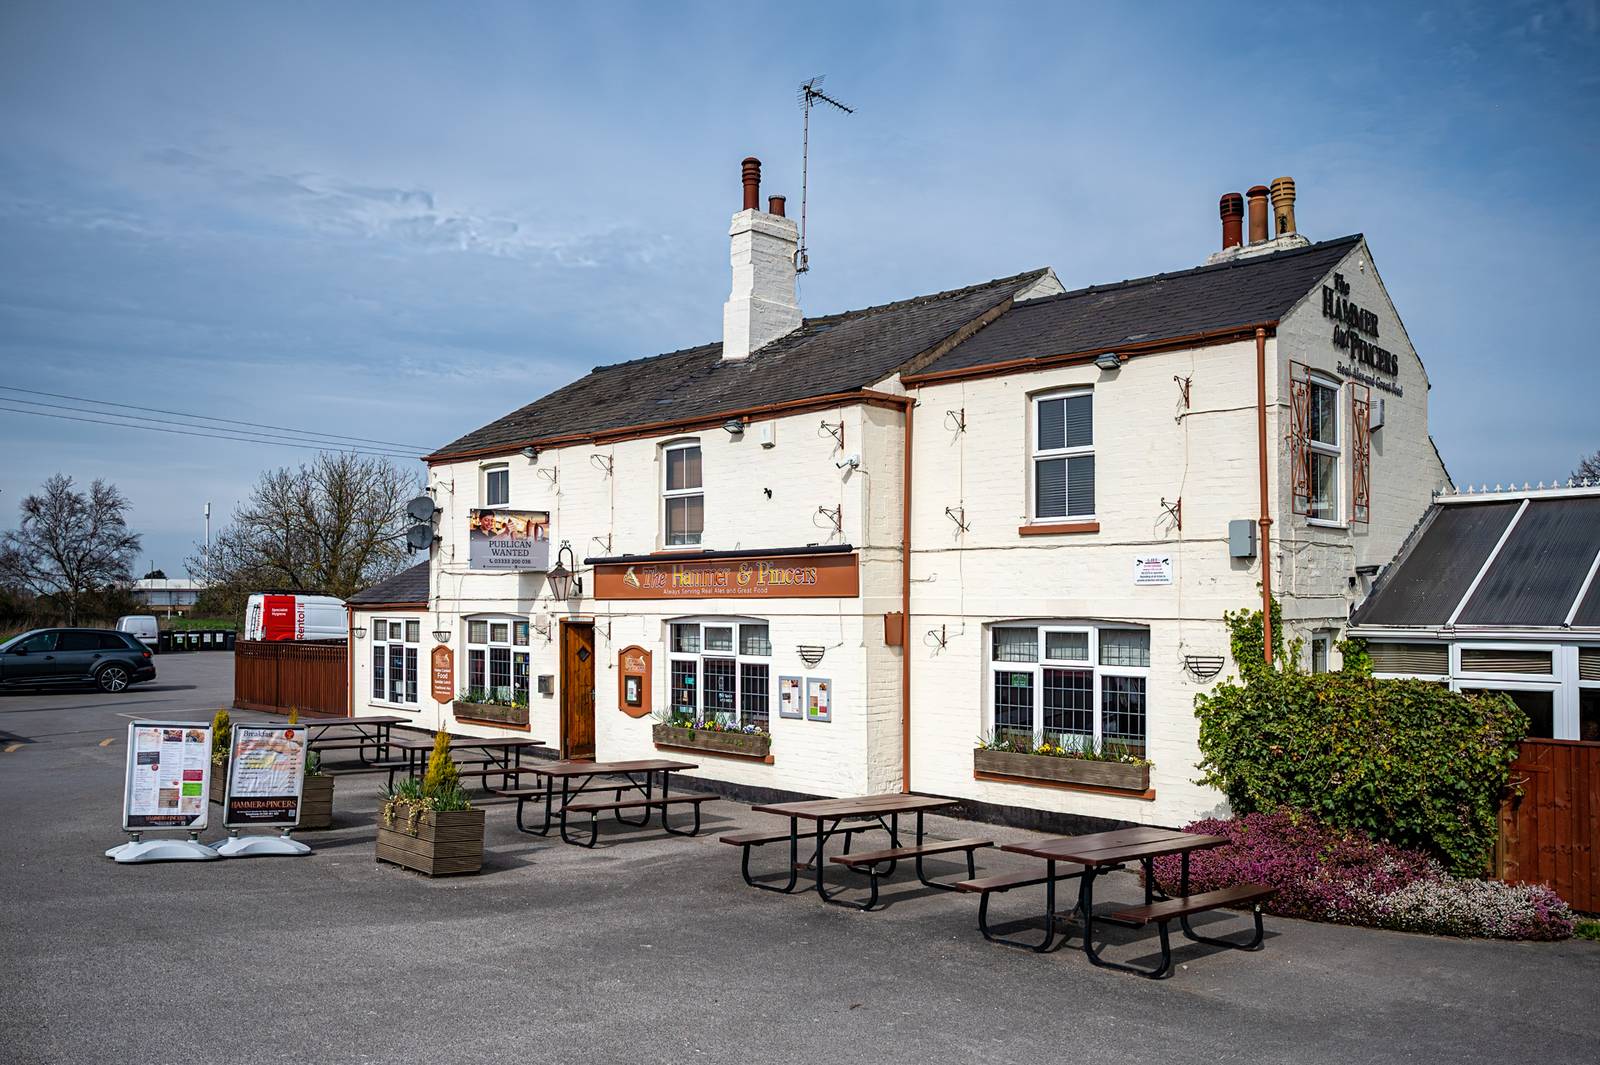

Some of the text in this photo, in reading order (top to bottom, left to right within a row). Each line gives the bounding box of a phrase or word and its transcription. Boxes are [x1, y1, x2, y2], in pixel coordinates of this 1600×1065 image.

[1334, 272, 1350, 296] The
[1322, 284, 1380, 338] HAMMER
[1350, 330, 1398, 376] PINCERS
[1336, 360, 1351, 376] Real
[489, 540, 532, 548] PUBLICAN
[642, 560, 817, 588] The Hammer & Pincers
